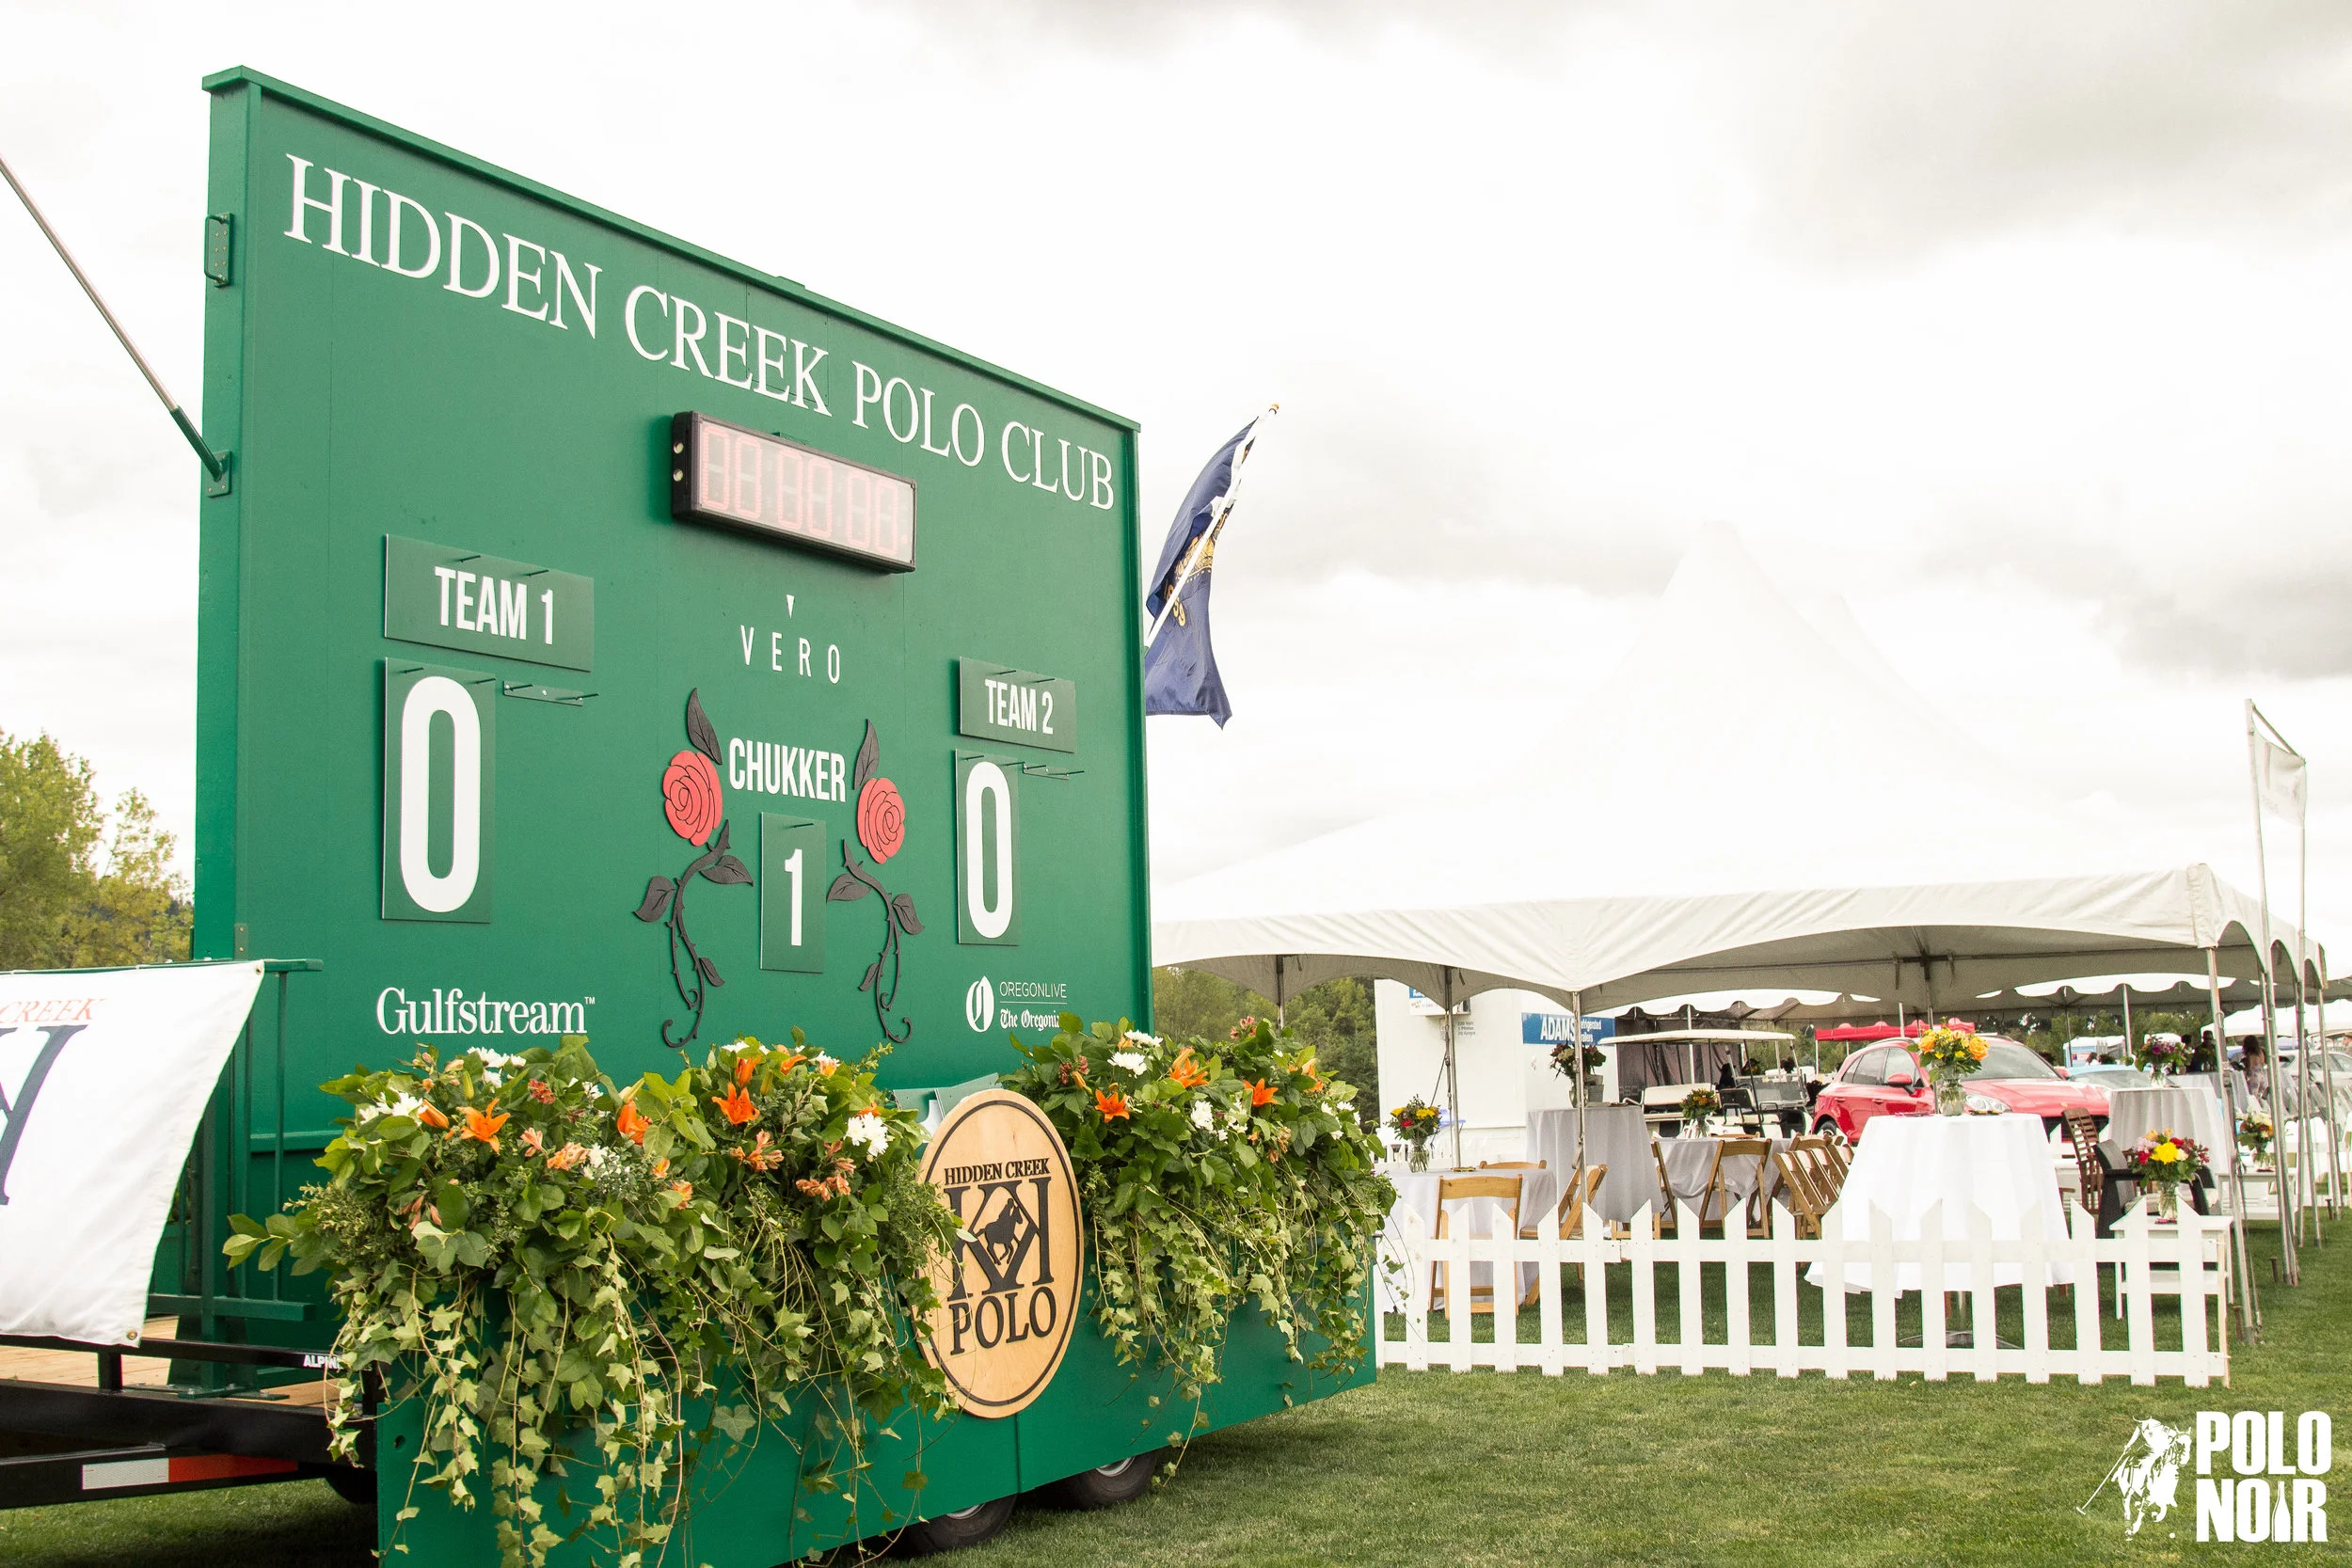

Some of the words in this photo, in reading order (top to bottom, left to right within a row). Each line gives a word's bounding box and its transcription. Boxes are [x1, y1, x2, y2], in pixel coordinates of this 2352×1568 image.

[284, 152, 603, 340] HIDDEN
[624, 284, 833, 418] CREEK
[850, 359, 985, 467] POLO
[1001, 420, 1114, 511] CLUB
[434, 565, 528, 641] TEAM
[540, 588, 555, 646] 1
[739, 624, 841, 685] VERO
[984, 677, 1038, 733] TEAM
[1041, 690, 1054, 736] 2
[399, 675, 482, 912] 0
[728, 736, 847, 803] CHUKKER
[964, 760, 1013, 940] 0
[784, 847, 803, 946] 1
[0, 997, 106, 1023] CREEK
[999, 981, 1068, 999] OREGONLIVE
[999, 1007, 1018, 1029] The
[1020, 1008, 1060, 1032] Oregoni
[944, 1162, 1005, 1186] HIDDEN
[1005, 1158, 1051, 1179] CREEK
[948, 1286, 1057, 1356] POLO
